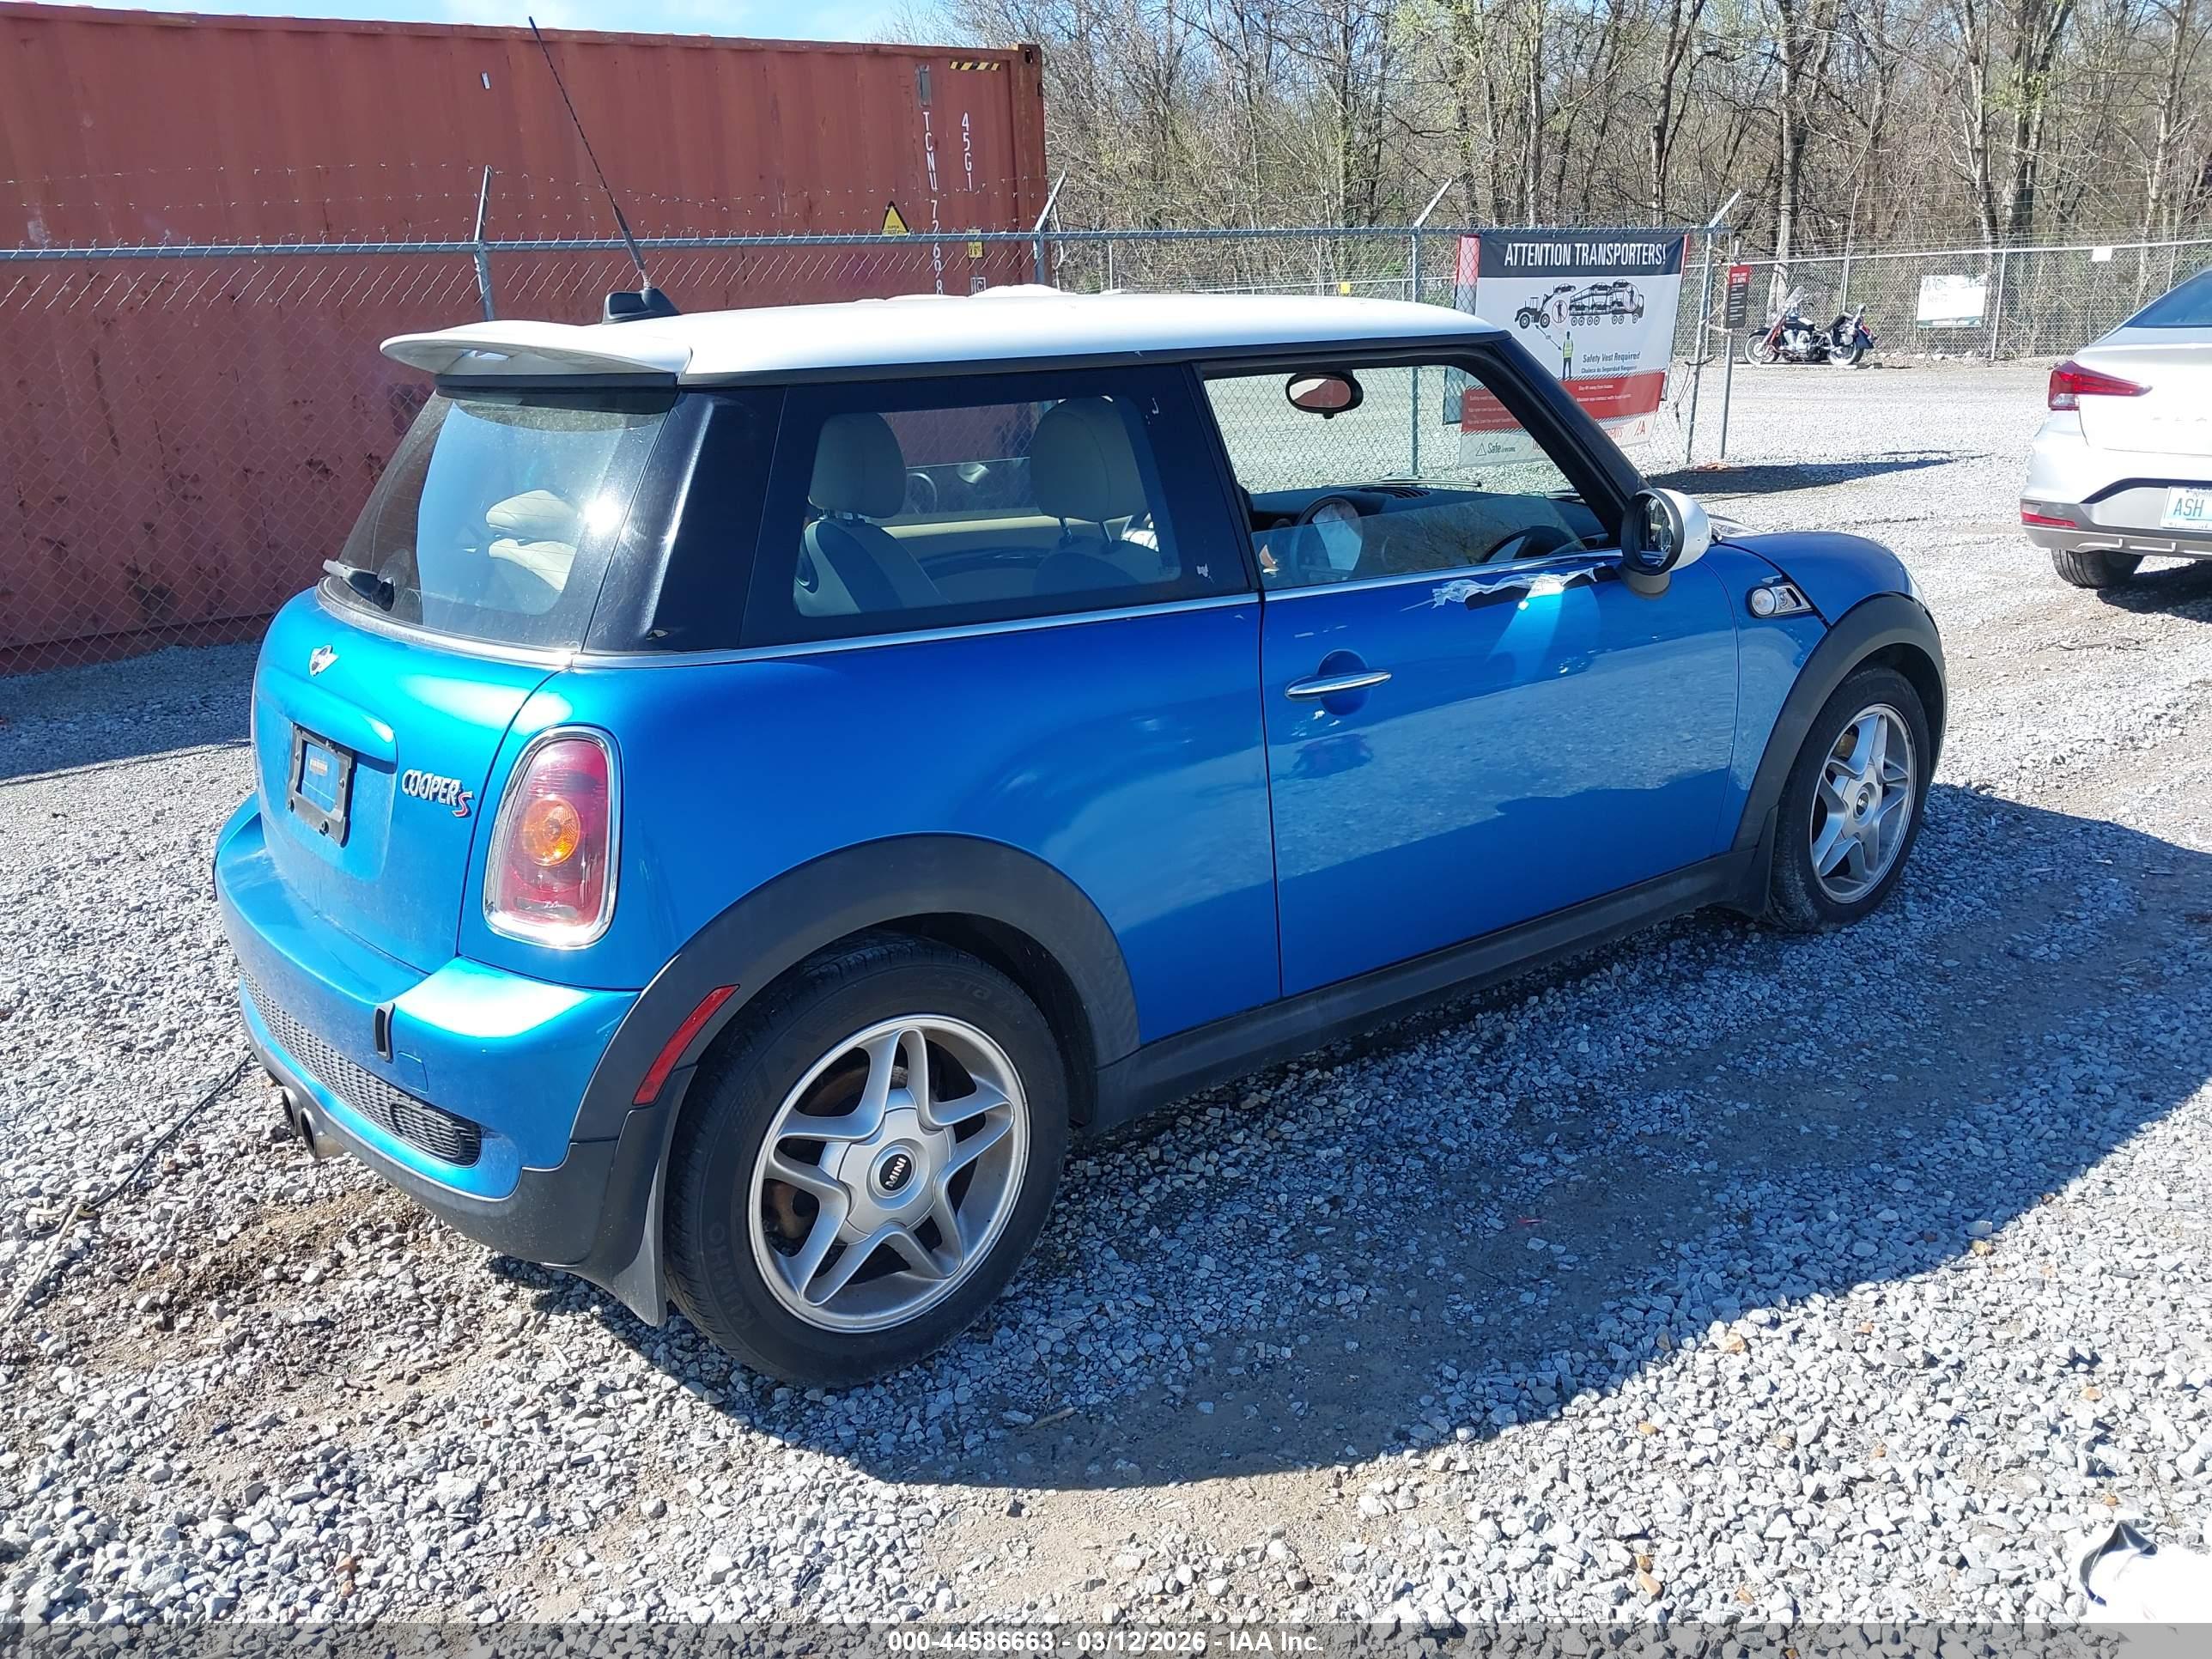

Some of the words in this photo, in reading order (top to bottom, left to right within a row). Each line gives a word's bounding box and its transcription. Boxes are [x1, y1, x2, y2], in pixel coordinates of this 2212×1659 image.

[923, 111, 938, 191] TCNU
[962, 112, 972, 191] 45G1
[1504, 243, 1571, 267] ATTENTION
[1575, 243, 1667, 266] TRANSPORTERS!
[1583, 354, 1601, 364] Safety
[1601, 353, 1613, 362] Vest
[1614, 351, 1641, 362] Required
[1487, 441, 1501, 454] Safe
[2173, 497, 2204, 517] ASH
[402, 769, 462, 806] COOPER
[453, 790, 473, 817] S
[884, 1157, 907, 1188] MINI
